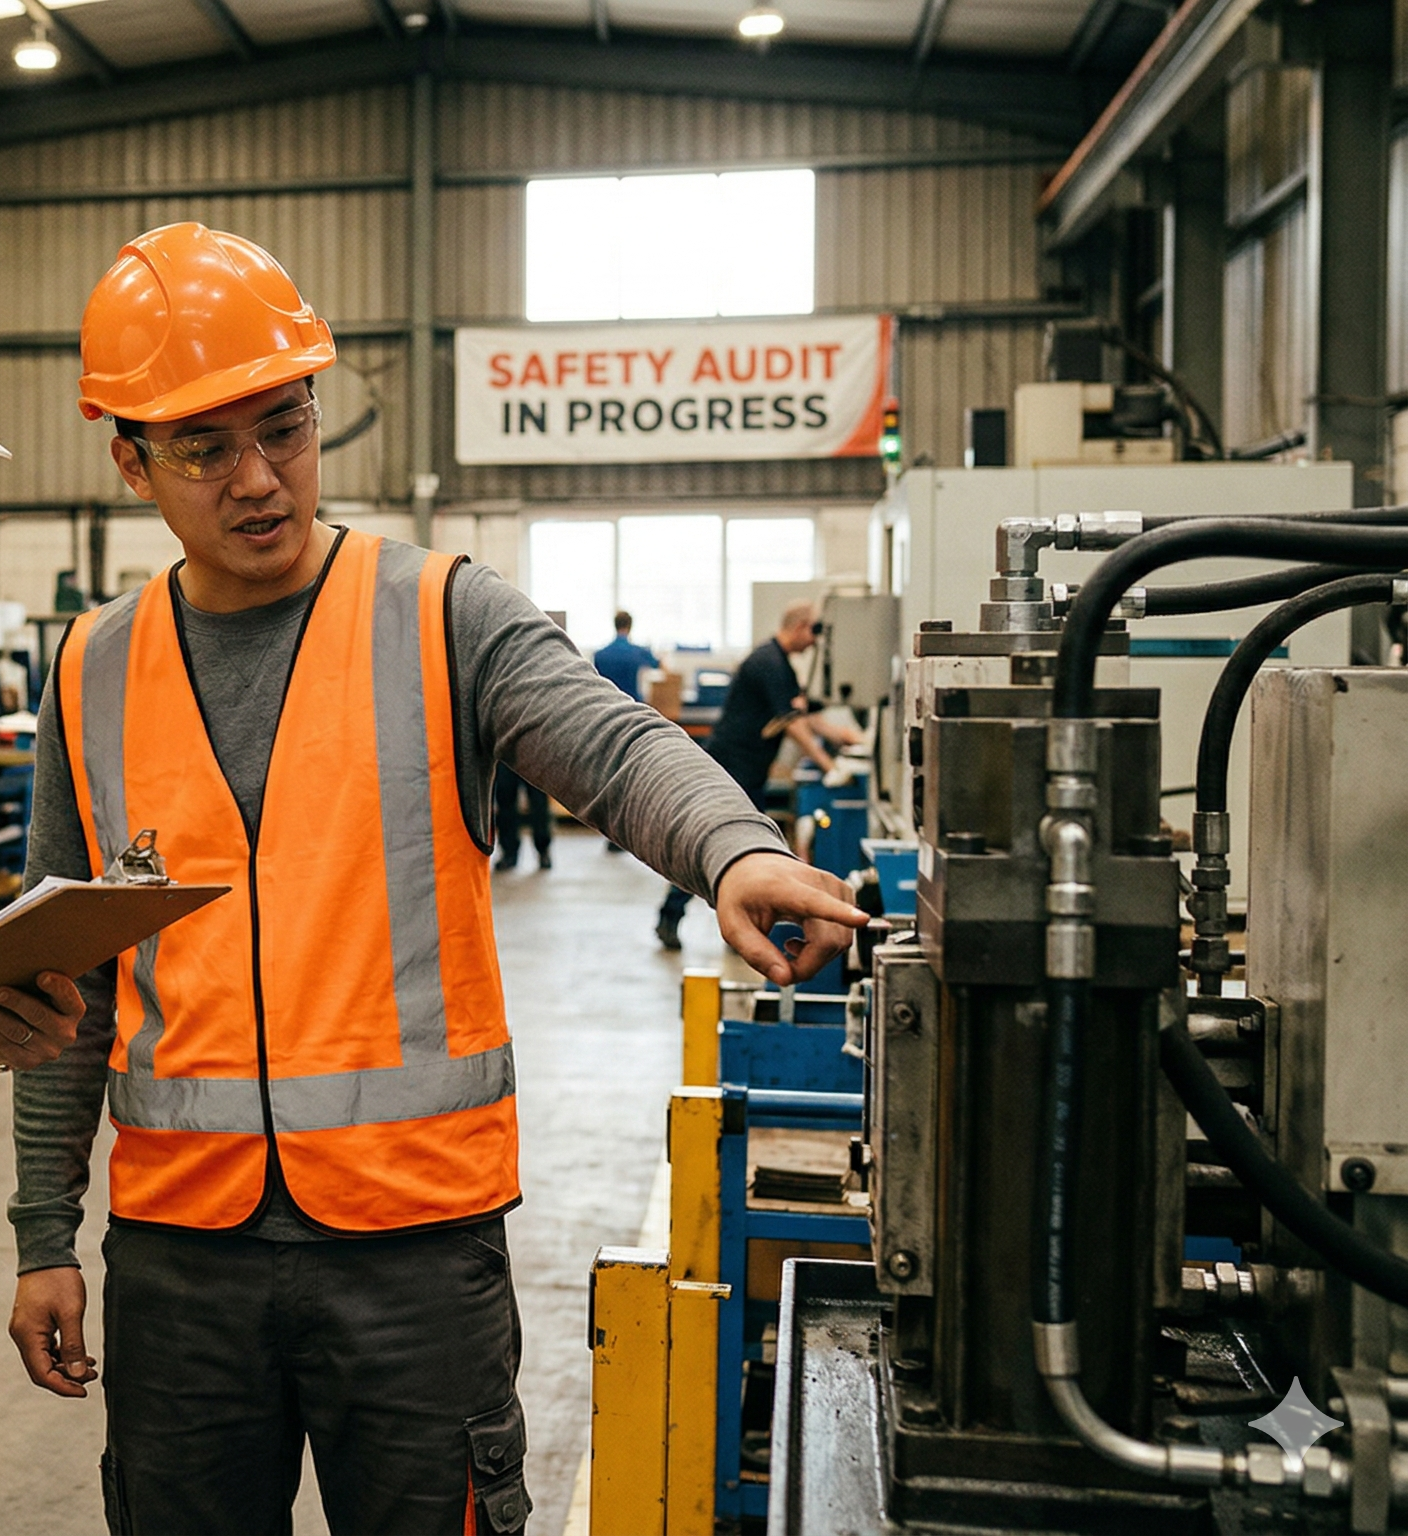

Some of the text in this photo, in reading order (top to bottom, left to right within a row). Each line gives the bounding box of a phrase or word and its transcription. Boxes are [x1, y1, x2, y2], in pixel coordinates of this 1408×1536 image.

[490, 345, 841, 388] SAFETY AUDIT
[502, 394, 829, 435] IN PROGRESS
